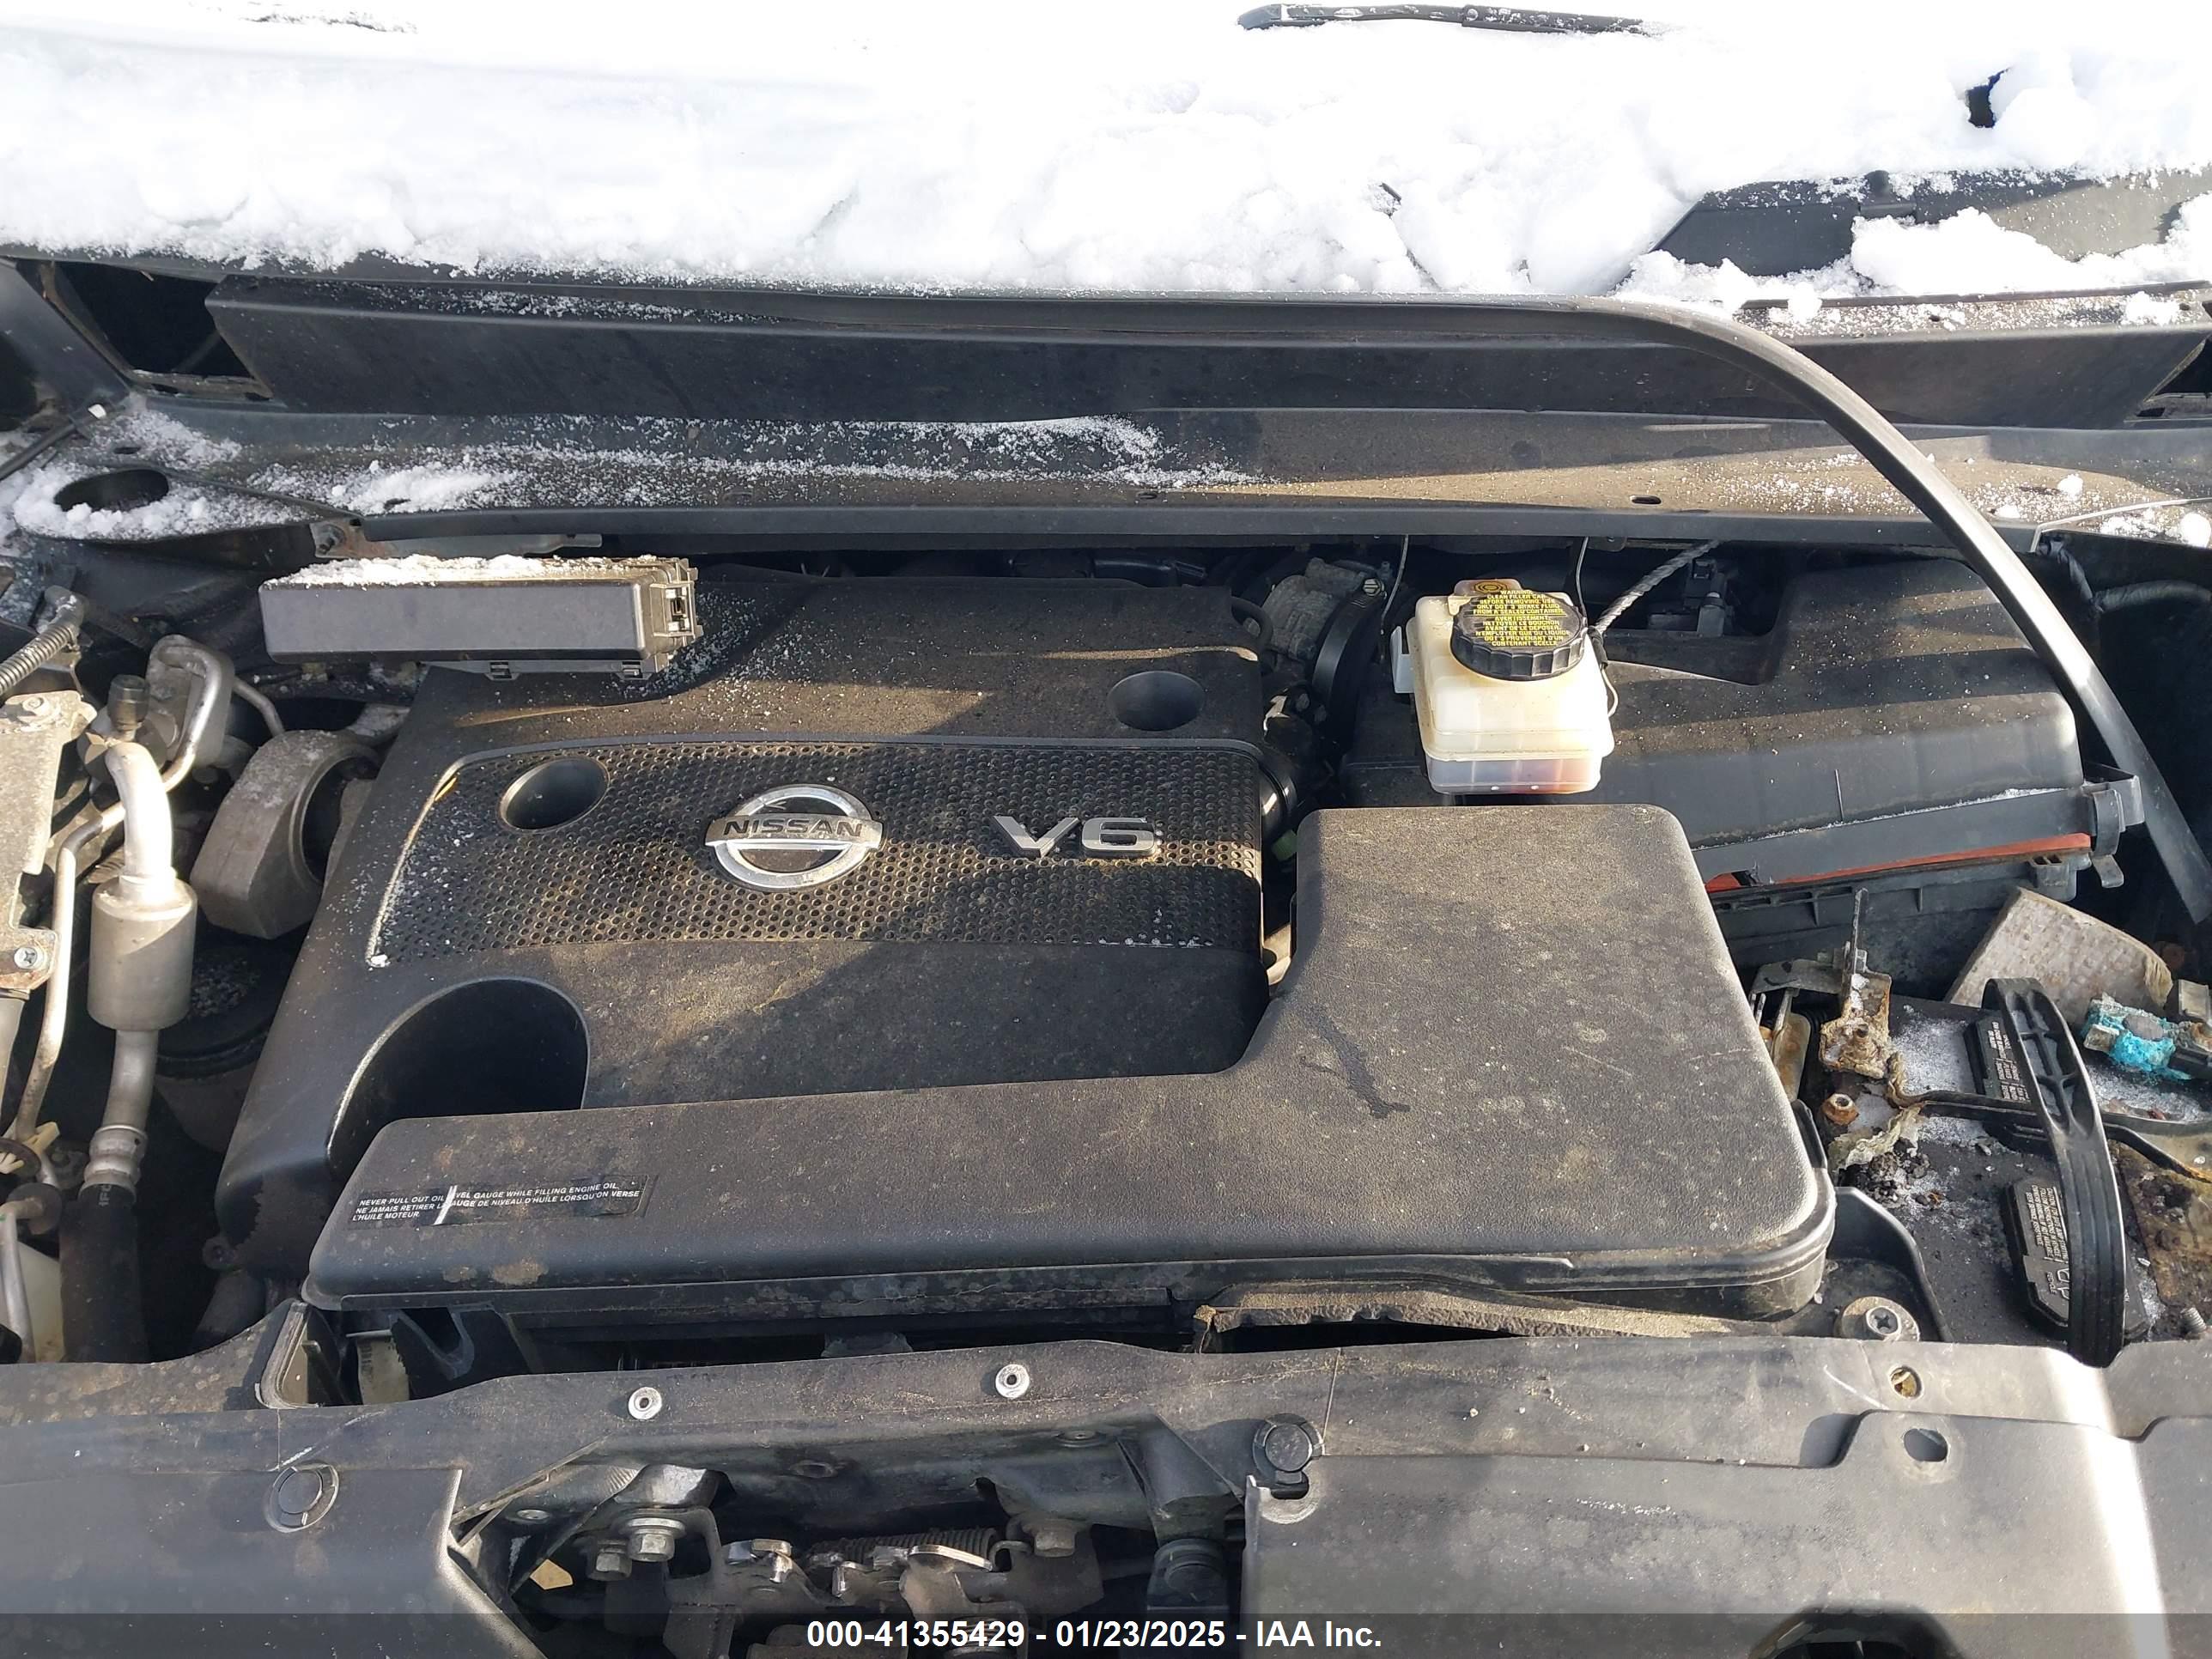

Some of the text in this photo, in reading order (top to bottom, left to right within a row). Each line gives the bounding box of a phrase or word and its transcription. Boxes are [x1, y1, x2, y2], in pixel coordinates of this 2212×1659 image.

[723, 819, 862, 837] NISSAN
[994, 816, 1156, 859] V6
[473, 1191, 505, 1200] GAUGE
[534, 1187, 568, 1195] FILLING
[568, 1183, 601, 1193] ENGINE
[368, 1205, 399, 1213] JAMAIS
[400, 1203, 434, 1212] RETIRER
[477, 1199, 489, 1207] DE
[490, 1197, 522, 1206] NIVEAU
[559, 1191, 609, 1202] LORSQU'ON
[352, 1212, 383, 1221] L'HUILE
